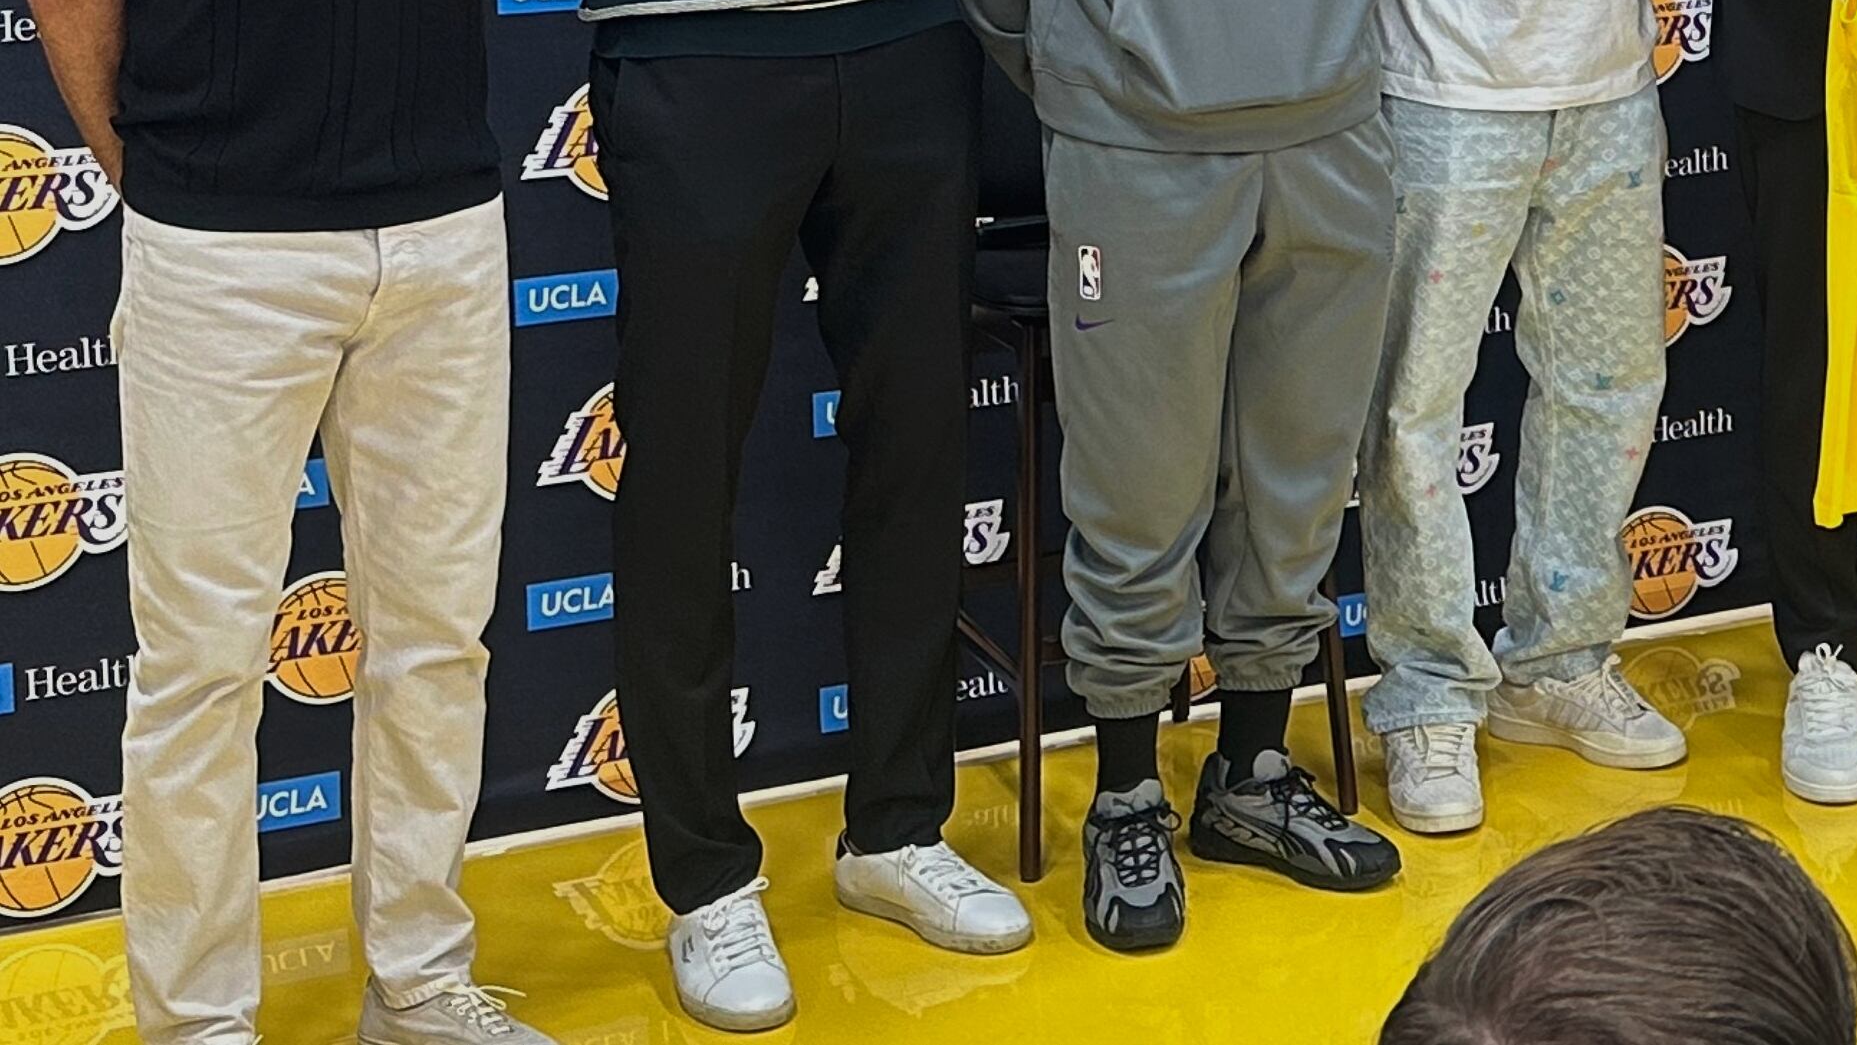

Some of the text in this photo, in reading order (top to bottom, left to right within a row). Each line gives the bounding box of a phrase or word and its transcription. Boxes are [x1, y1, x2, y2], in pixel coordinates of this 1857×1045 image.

[1657, 12, 1712, 55] ERS
[1664, 148, 1729, 178] ealth
[0, 170, 100, 221] ERS
[528, 282, 607, 311] UCLA
[1665, 276, 1717, 316] ERS
[968, 376, 1019, 408] alth
[0, 476, 124, 501] OS ANGELES
[0, 494, 124, 541] KERS
[1630, 523, 1727, 549] LOS ANGELES
[1631, 540, 1722, 584] KERS
[298, 603, 333, 618] LOS
[25, 657, 127, 701] Healt
[1, 802, 123, 831] LOS ANGELE
